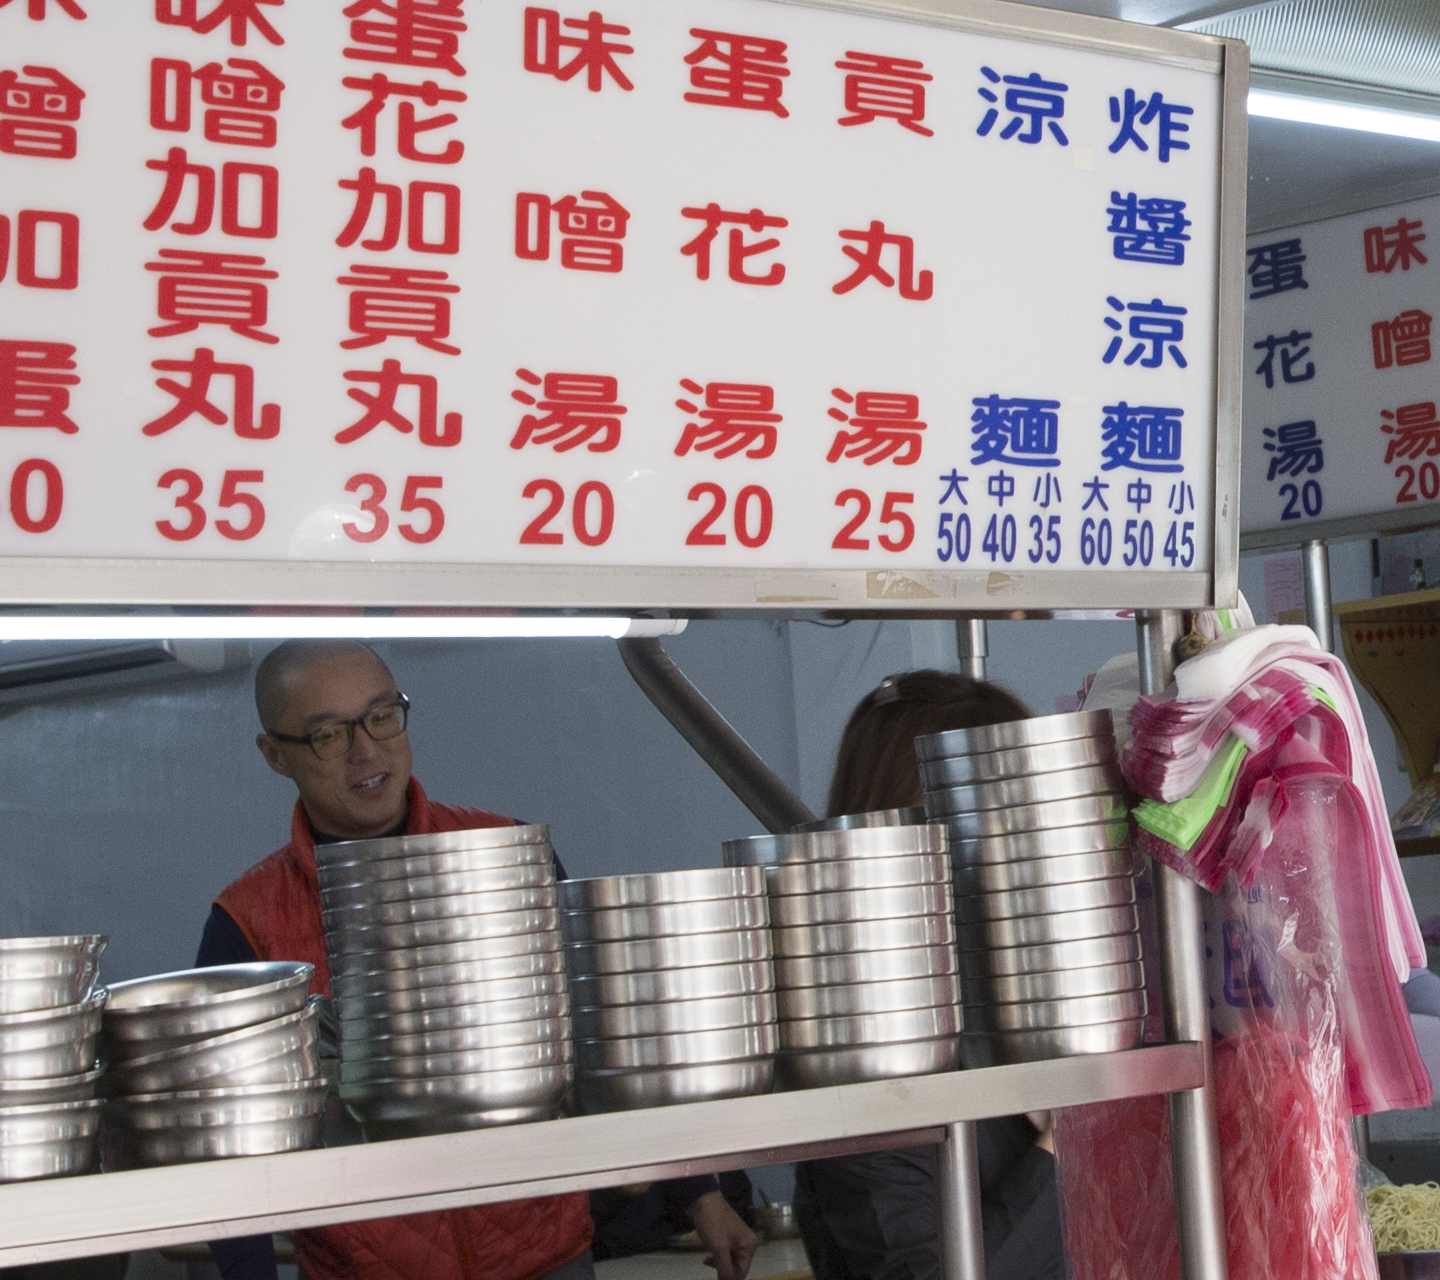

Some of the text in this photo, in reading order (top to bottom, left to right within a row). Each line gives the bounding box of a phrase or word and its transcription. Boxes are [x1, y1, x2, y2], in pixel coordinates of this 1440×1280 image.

[510, 7, 634, 546] 味噌湯 20
[674, 28, 790, 548] 蛋花湯 20
[827, 51, 933, 552] 貢丸湯 25
[971, 67, 1068, 467] 涼麵
[1101, 89, 1193, 472] 炸醬涼麵
[1248, 239, 1324, 521] 蛋花湯 20
[156, 469, 265, 541] 35
[343, 474, 444, 543] 35
[938, 469, 1061, 508] 大 中 小
[1082, 476, 1194, 515] 大 中 小
[1394, 462, 1440, 504] 20
[937, 513, 1061, 563] 50 40 35
[1081, 518, 1194, 567] 60 50 45
